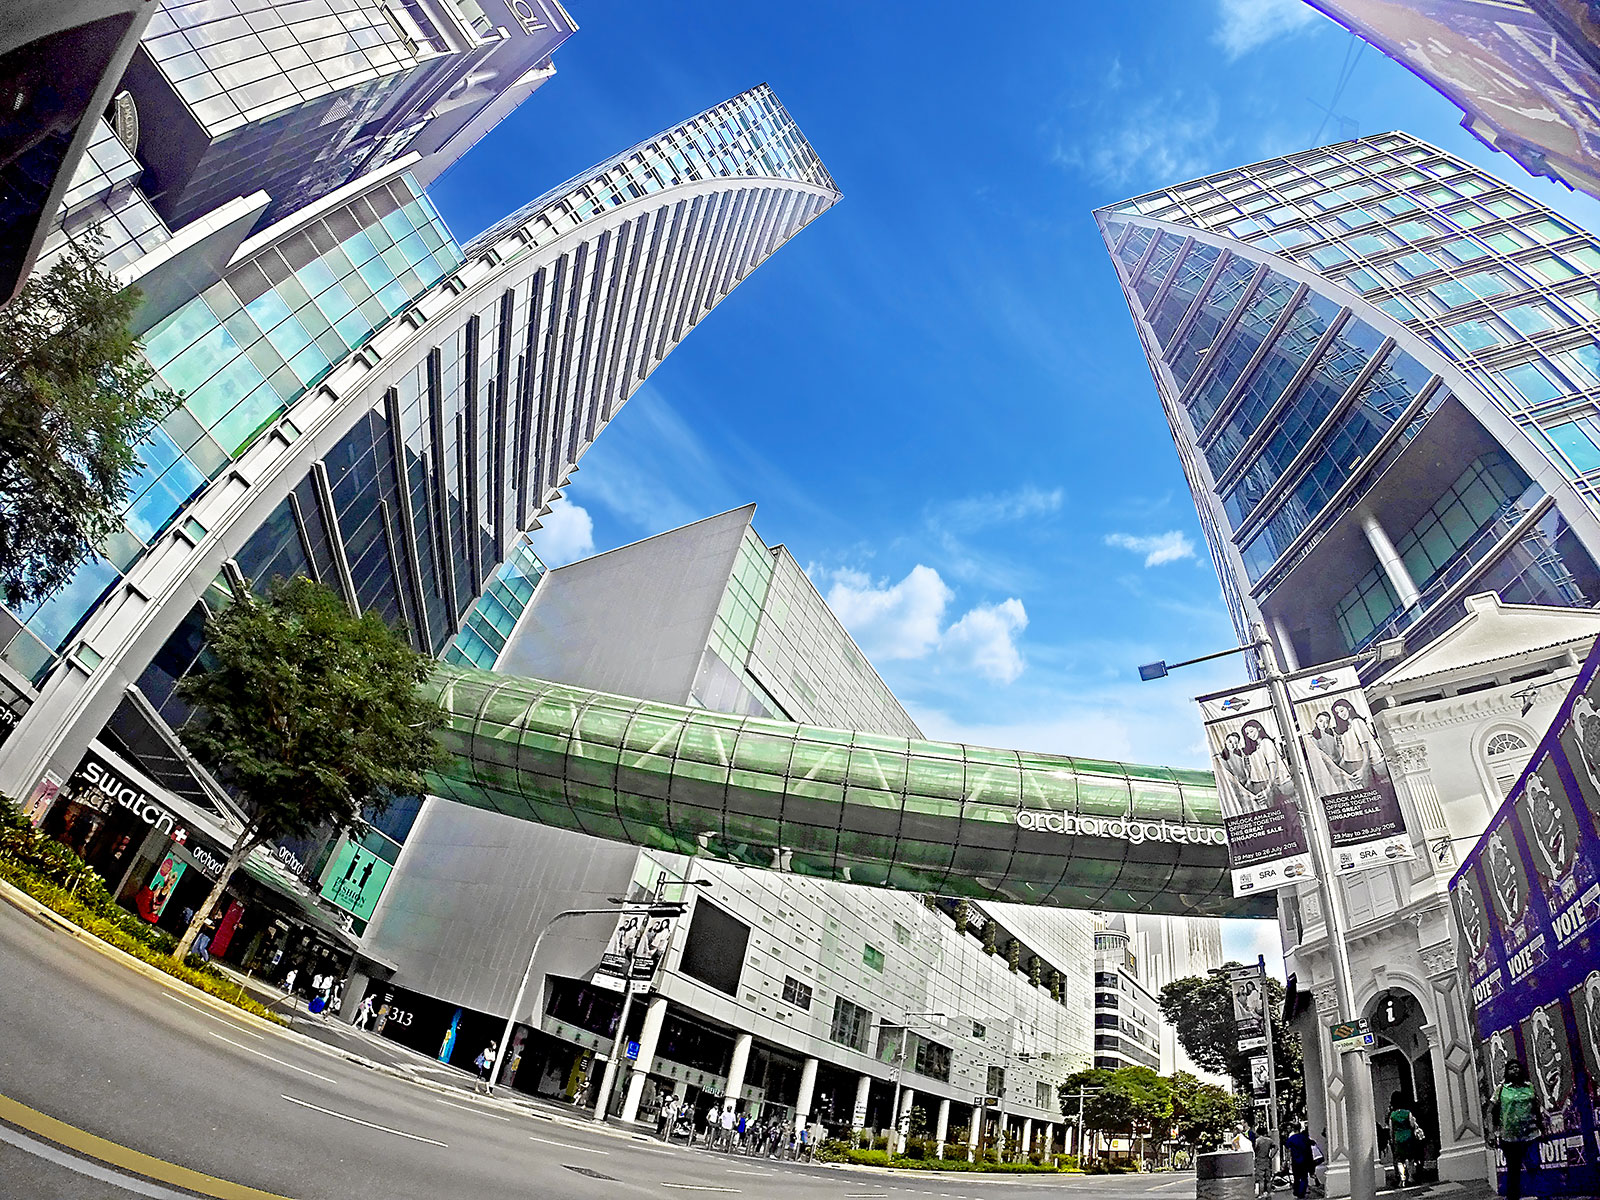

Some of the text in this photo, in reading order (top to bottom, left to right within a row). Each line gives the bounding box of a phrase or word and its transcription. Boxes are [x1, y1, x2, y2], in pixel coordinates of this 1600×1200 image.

[82, 762, 175, 835] swatch
[1325, 790, 1378, 806] UNLOCK AMAZING
[1350, 795, 1382, 805] TOGETHER
[1328, 810, 1363, 821] SINGAPORE
[1341, 805, 1361, 813] GREAT
[1228, 810, 1282, 827] UNLOCK AMAZING
[1253, 814, 1286, 826] TOGETHER
[1016, 809, 1228, 845] orchardgatewa
[1244, 825, 1264, 834] GREAT
[1231, 830, 1266, 843] SINGAPORE
[1359, 849, 1378, 859] SRA
[1259, 869, 1277, 880] SRA
[1552, 899, 1586, 942] VOTE
[1507, 944, 1534, 978] VOTE
[1472, 976, 1493, 1005] VOTE
[388, 1006, 414, 1027] 313
[1496, 1148, 1507, 1167] VO
[1539, 1138, 1568, 1163] VOTE
